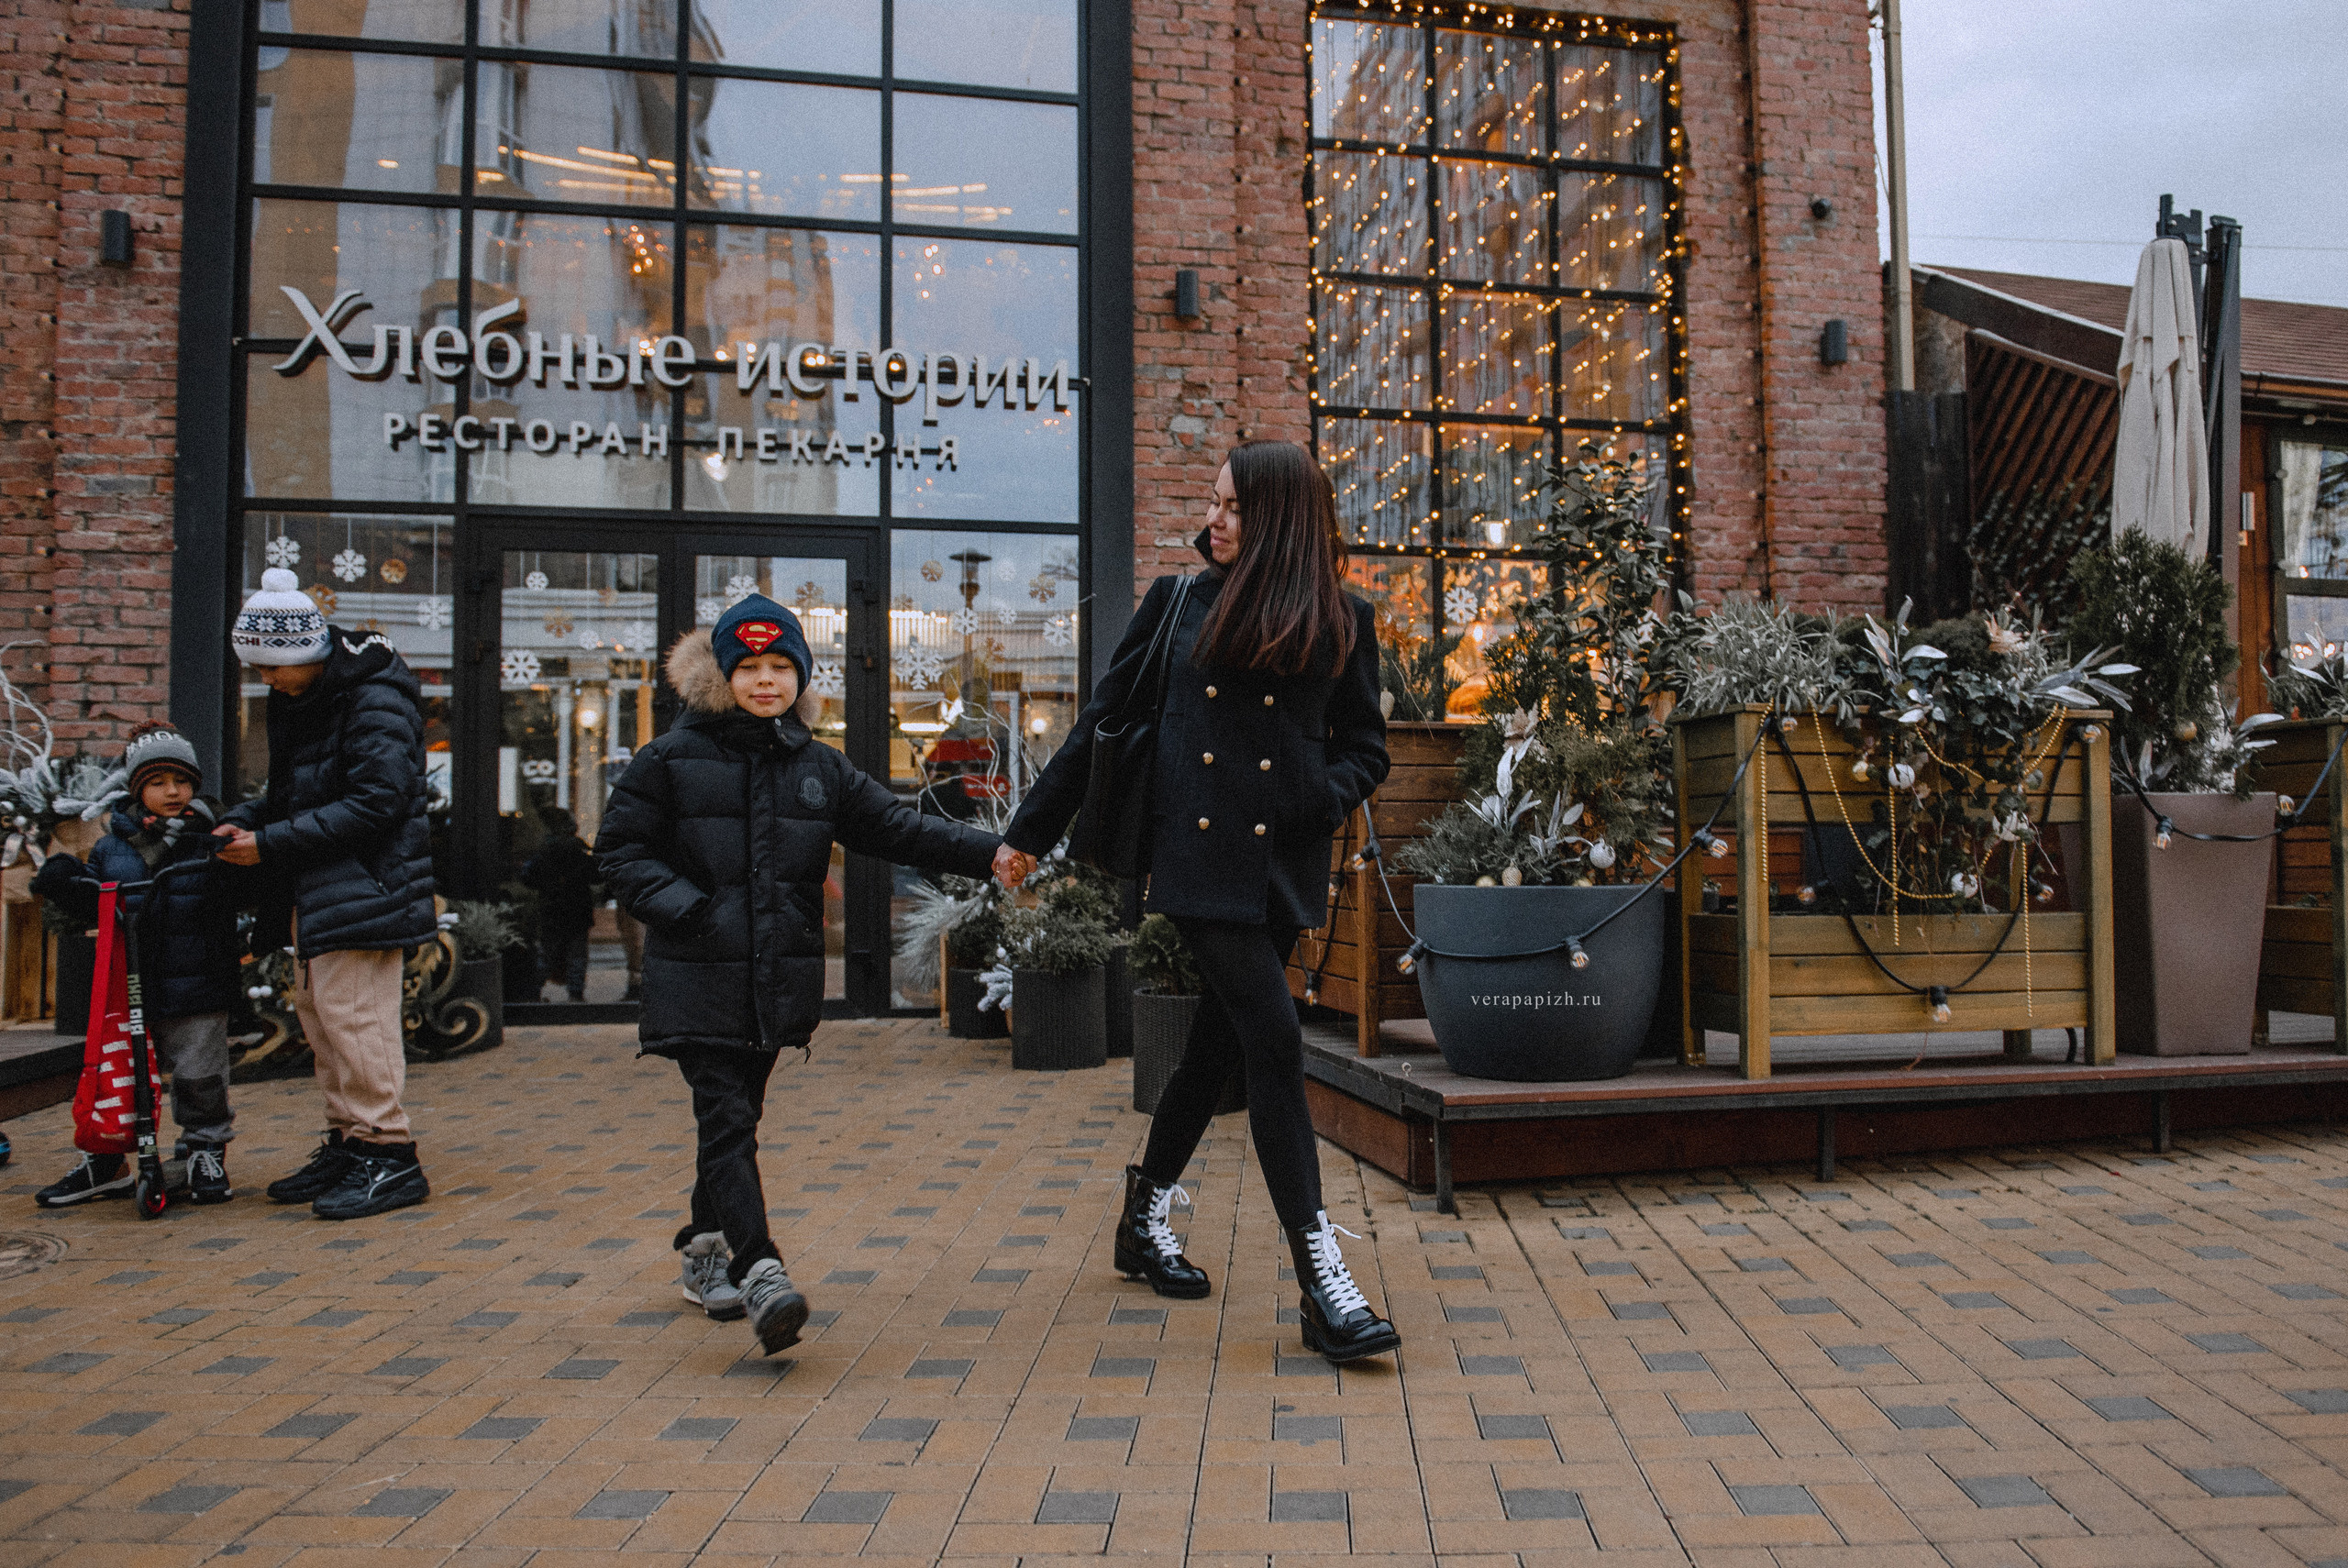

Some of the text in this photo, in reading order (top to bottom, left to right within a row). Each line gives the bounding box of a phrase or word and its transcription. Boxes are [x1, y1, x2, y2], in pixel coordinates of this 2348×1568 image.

[274, 285, 1068, 422] Хлебные истории
[382, 413, 960, 467] РЕСТОРАН ПЕКАРНЯ
